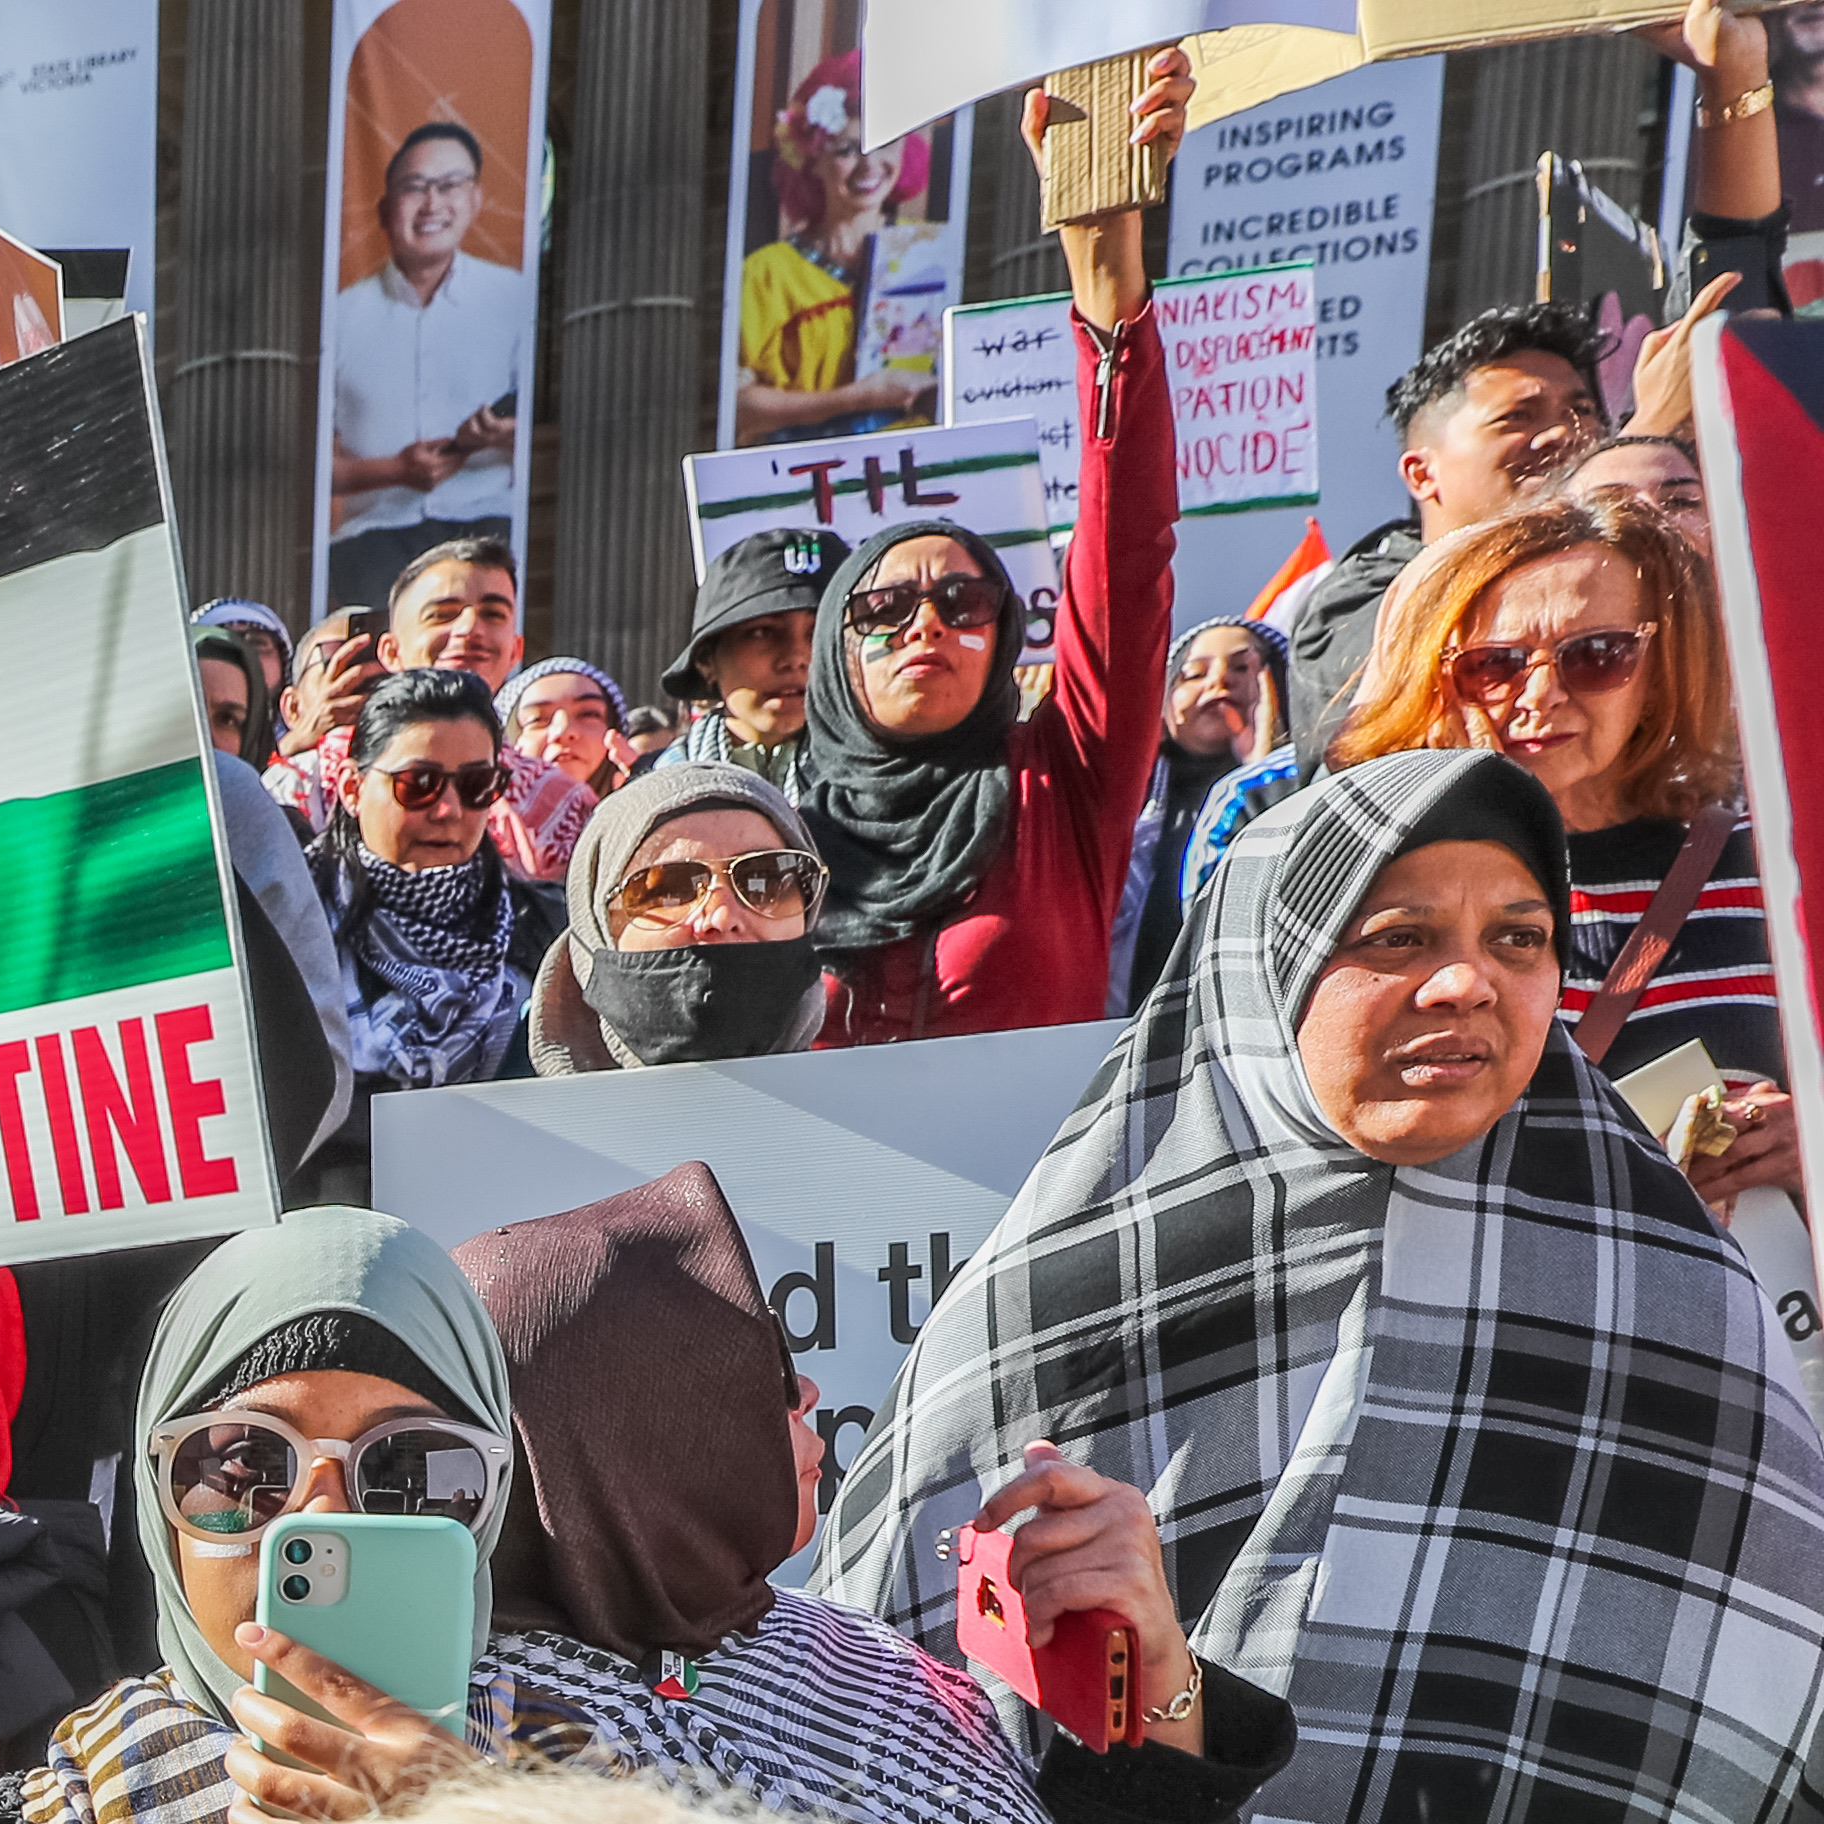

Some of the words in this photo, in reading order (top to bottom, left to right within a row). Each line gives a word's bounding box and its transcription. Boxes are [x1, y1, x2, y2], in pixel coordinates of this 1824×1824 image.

[76, 47, 139, 72] LIBRARY
[1218, 100, 1397, 152] INSPIRING
[1203, 135, 1407, 188] PROGRAMS
[1201, 193, 1400, 245] INCREDIBLE
[1175, 372, 1304, 421] PATION
[1176, 420, 1311, 480] NOCIDE
